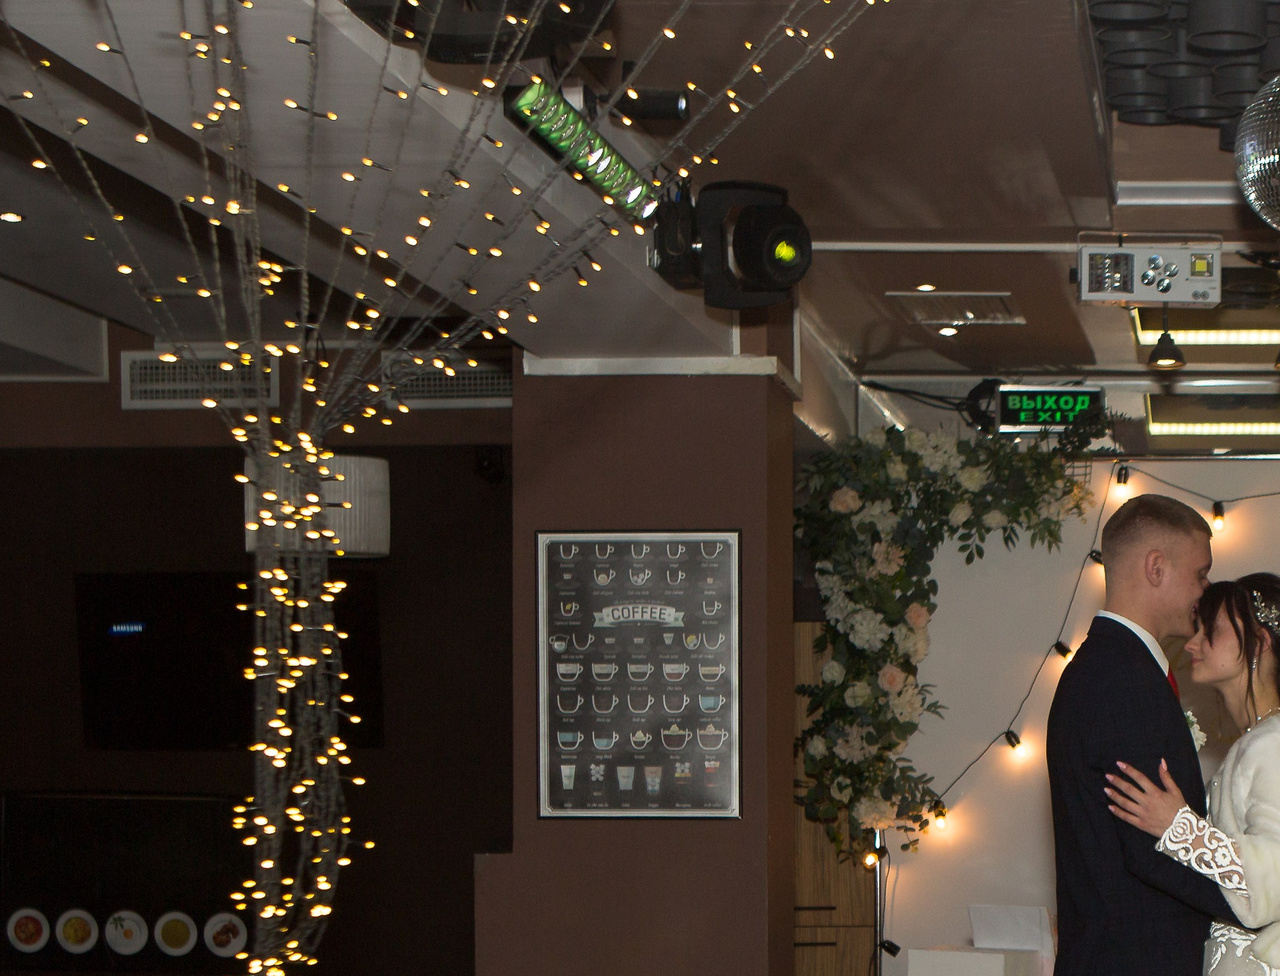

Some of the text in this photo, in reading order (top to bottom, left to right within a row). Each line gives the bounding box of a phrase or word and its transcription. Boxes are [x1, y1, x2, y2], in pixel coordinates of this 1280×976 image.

[1007, 394, 1091, 412] ВЫХОД
[1019, 411, 1078, 423] EXIT
[611, 606, 668, 621] COFFEE
